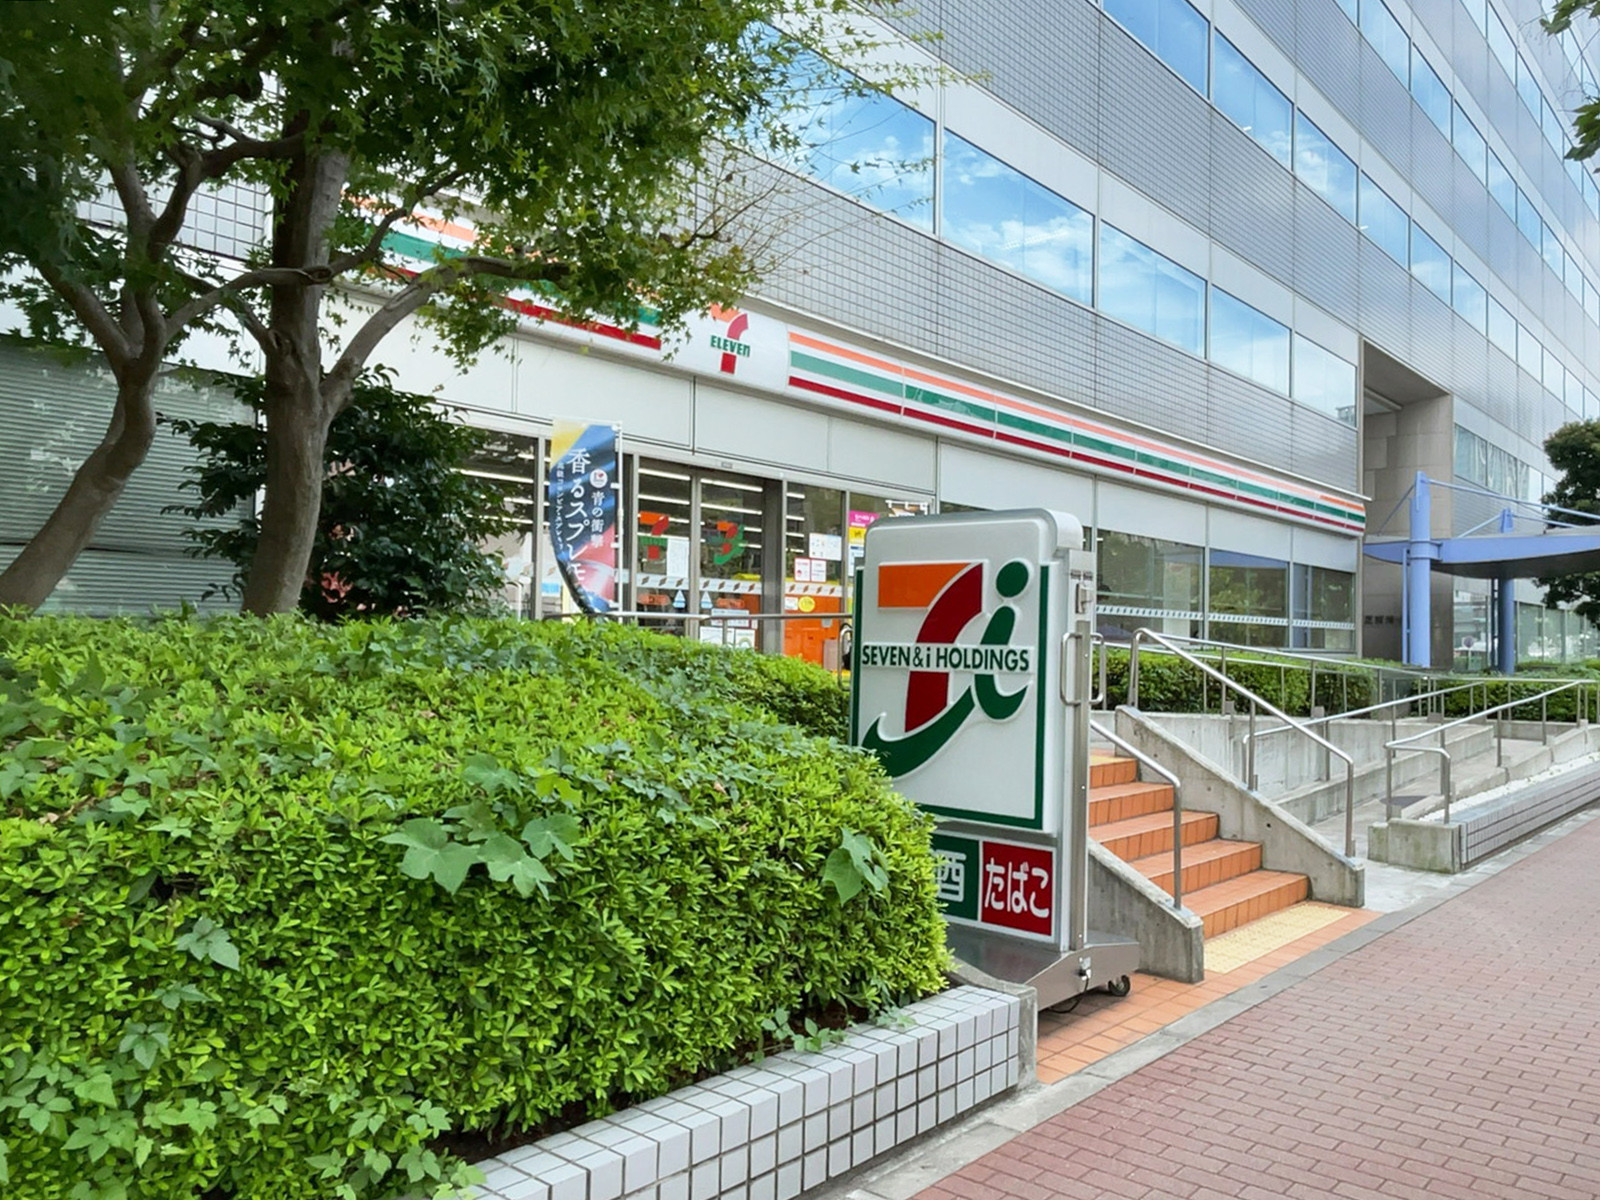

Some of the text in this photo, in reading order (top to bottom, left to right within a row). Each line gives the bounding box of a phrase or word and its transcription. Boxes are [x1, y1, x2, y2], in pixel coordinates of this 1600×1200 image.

[566, 448, 591, 582] 香るスプレモ
[936, 647, 1030, 671] HOLDINGS
[984, 857, 1050, 918] たばこ
